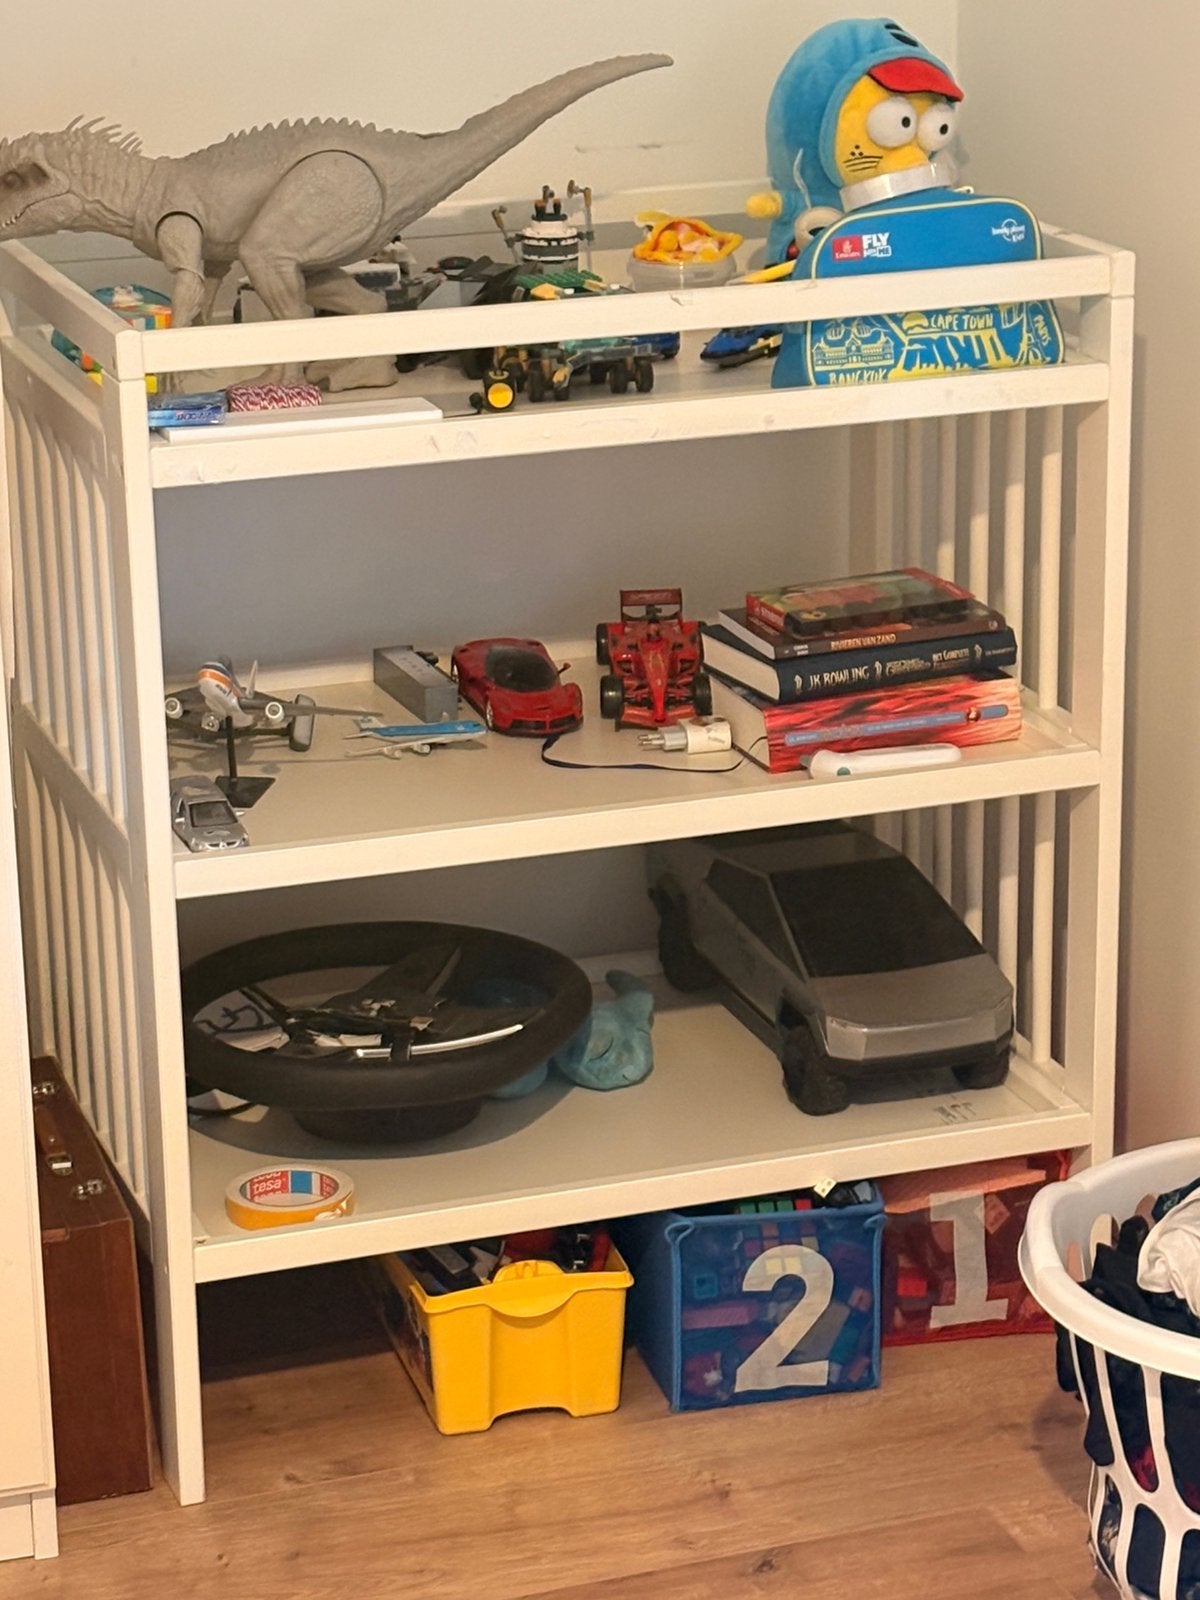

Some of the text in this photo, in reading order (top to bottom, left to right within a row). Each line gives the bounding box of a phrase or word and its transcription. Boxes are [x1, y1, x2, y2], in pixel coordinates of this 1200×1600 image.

[862, 231, 890, 249] FLY
[931, 312, 993, 331] CAPE TOWN
[252, 1178, 282, 1193] tesa
[928, 1190, 1009, 1329] 1
[734, 1245, 836, 1393] 2
